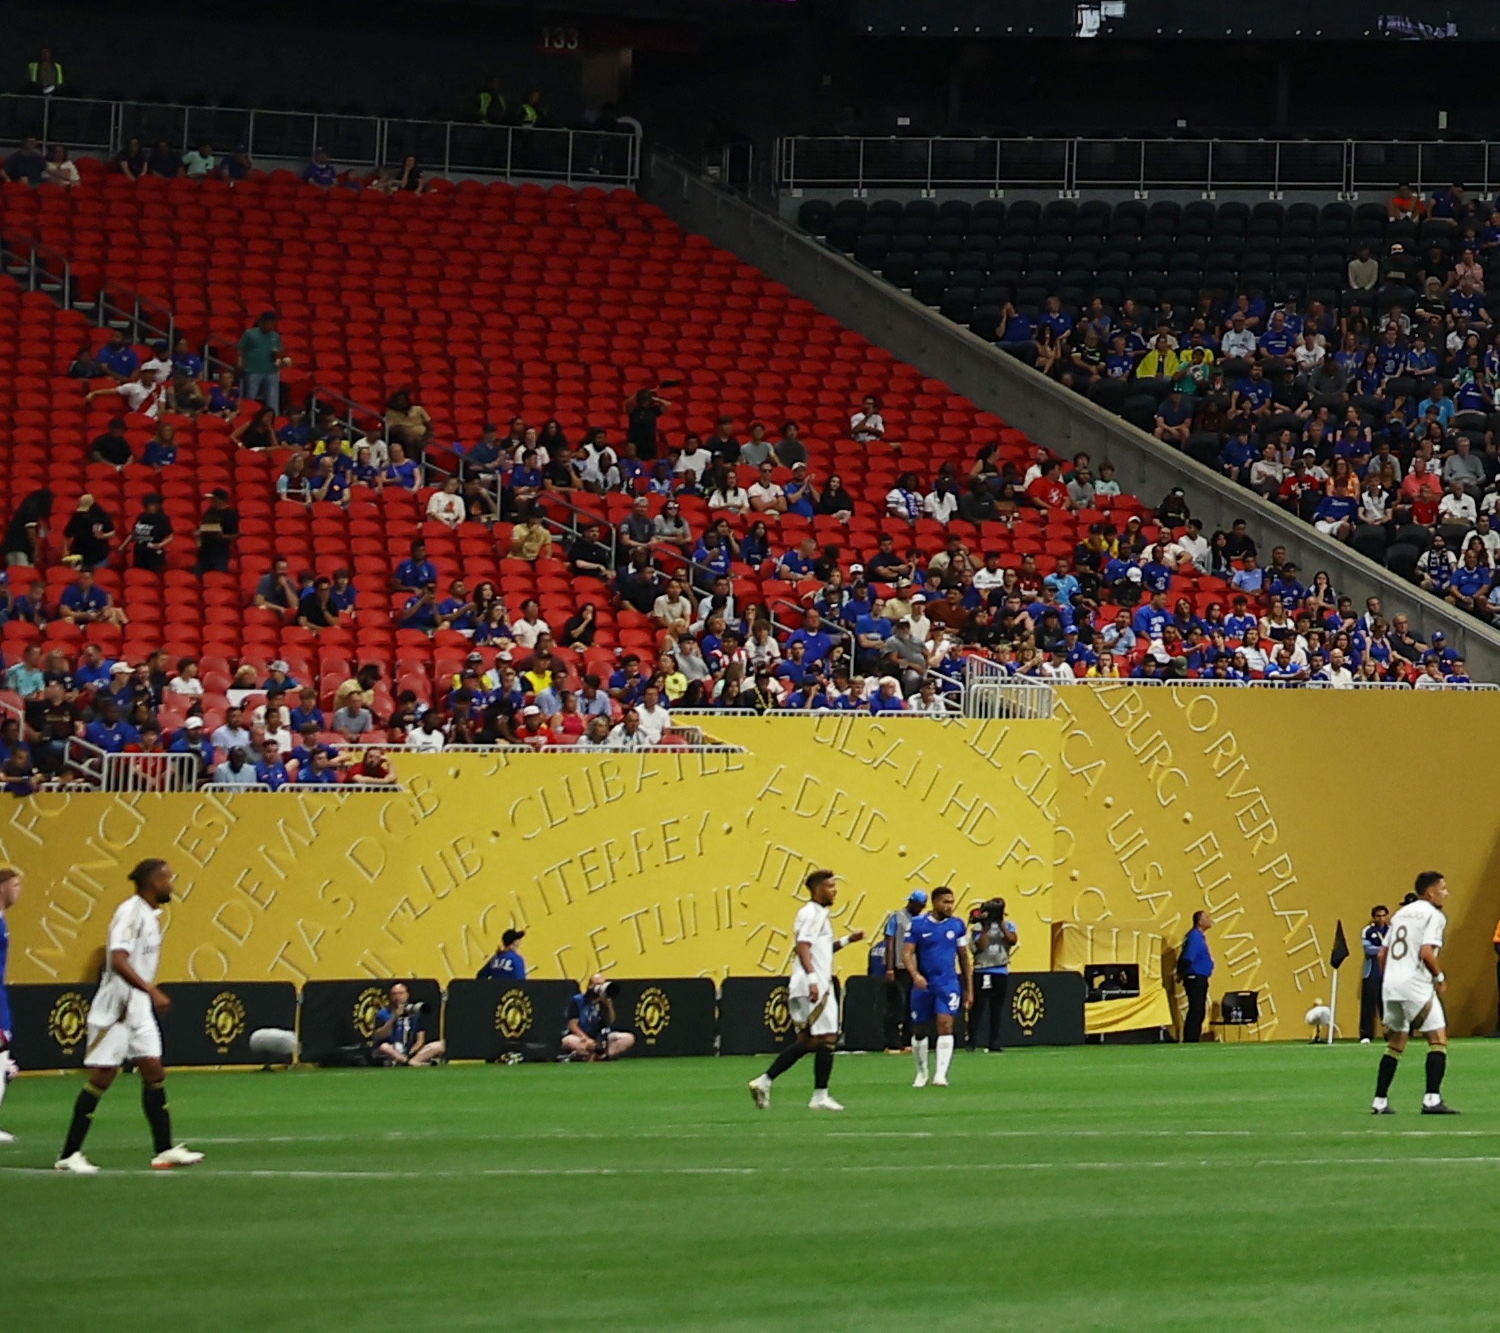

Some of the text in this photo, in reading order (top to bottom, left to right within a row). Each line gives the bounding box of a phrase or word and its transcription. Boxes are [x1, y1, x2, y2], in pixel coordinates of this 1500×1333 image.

[1203, 730, 1329, 994] RIVER PLATE
[1391, 924, 1409, 962] 8
